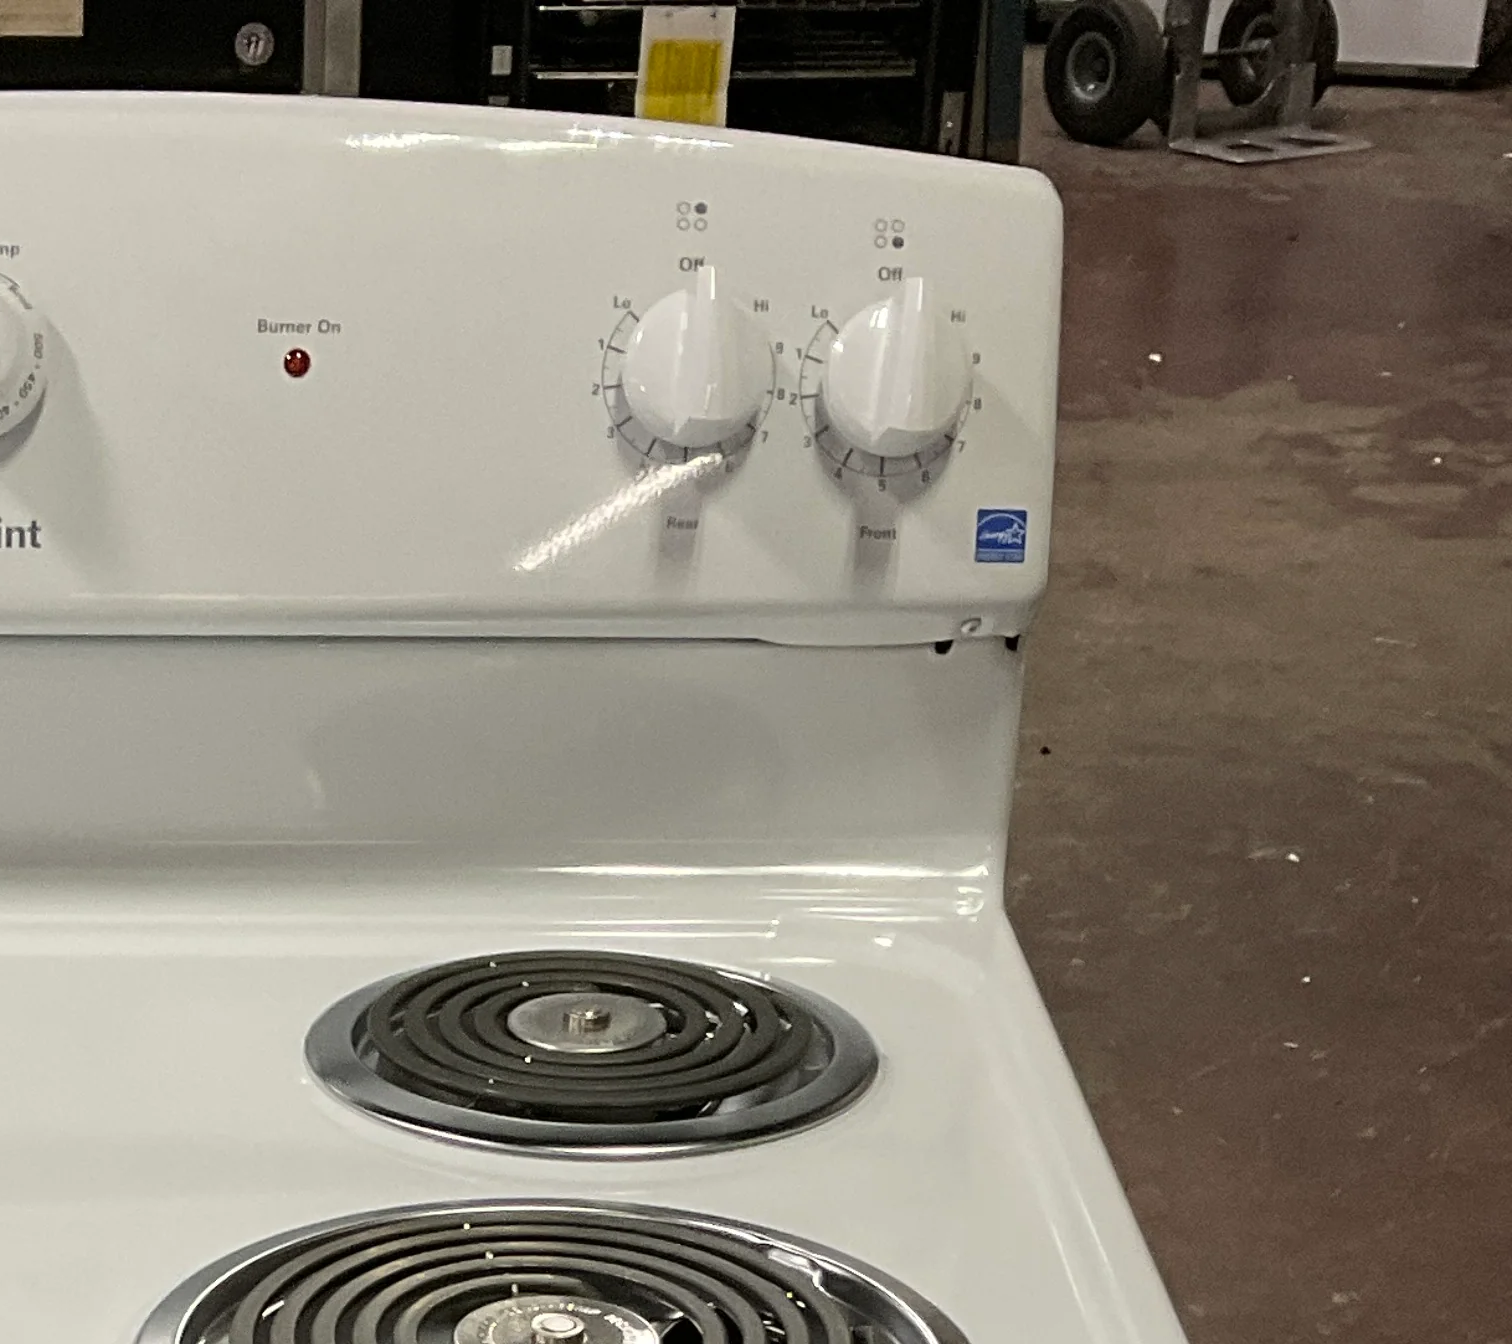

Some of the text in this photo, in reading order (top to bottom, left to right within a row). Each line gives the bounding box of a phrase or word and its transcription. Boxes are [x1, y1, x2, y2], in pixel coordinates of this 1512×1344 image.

[679, 256, 705, 272] Off
[878, 266, 903, 281] Off
[613, 296, 631, 309] Lo
[753, 300, 769, 312] Hi
[811, 305, 828, 319] Lo
[950, 310, 966, 323] Hi
[257, 318, 342, 333] Burner On
[860, 525, 897, 540] Front
